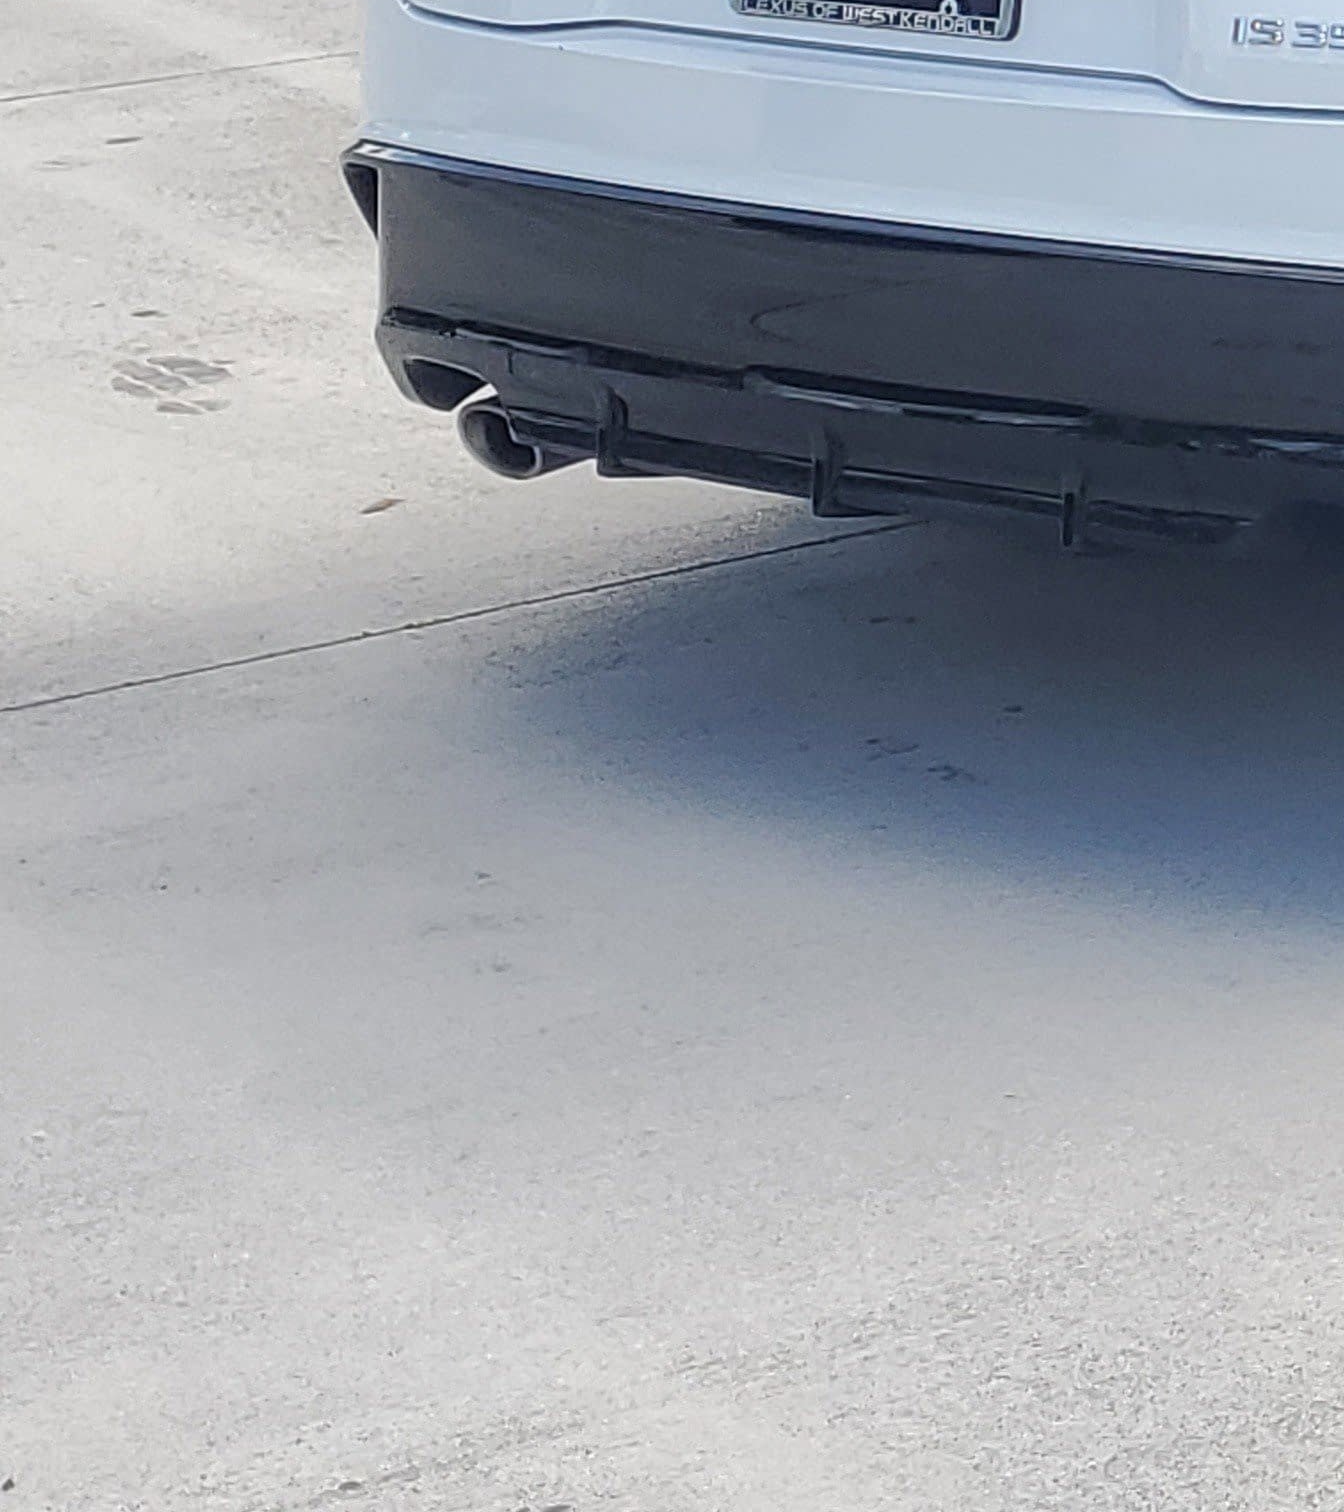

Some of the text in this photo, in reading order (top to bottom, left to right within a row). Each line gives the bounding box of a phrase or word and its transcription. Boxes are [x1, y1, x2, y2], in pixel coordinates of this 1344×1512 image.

[812, 1, 839, 19] OF
[842, 5, 897, 26] WEST
[899, 9, 994, 37] KENDALL
[1232, 17, 1285, 46] IS
